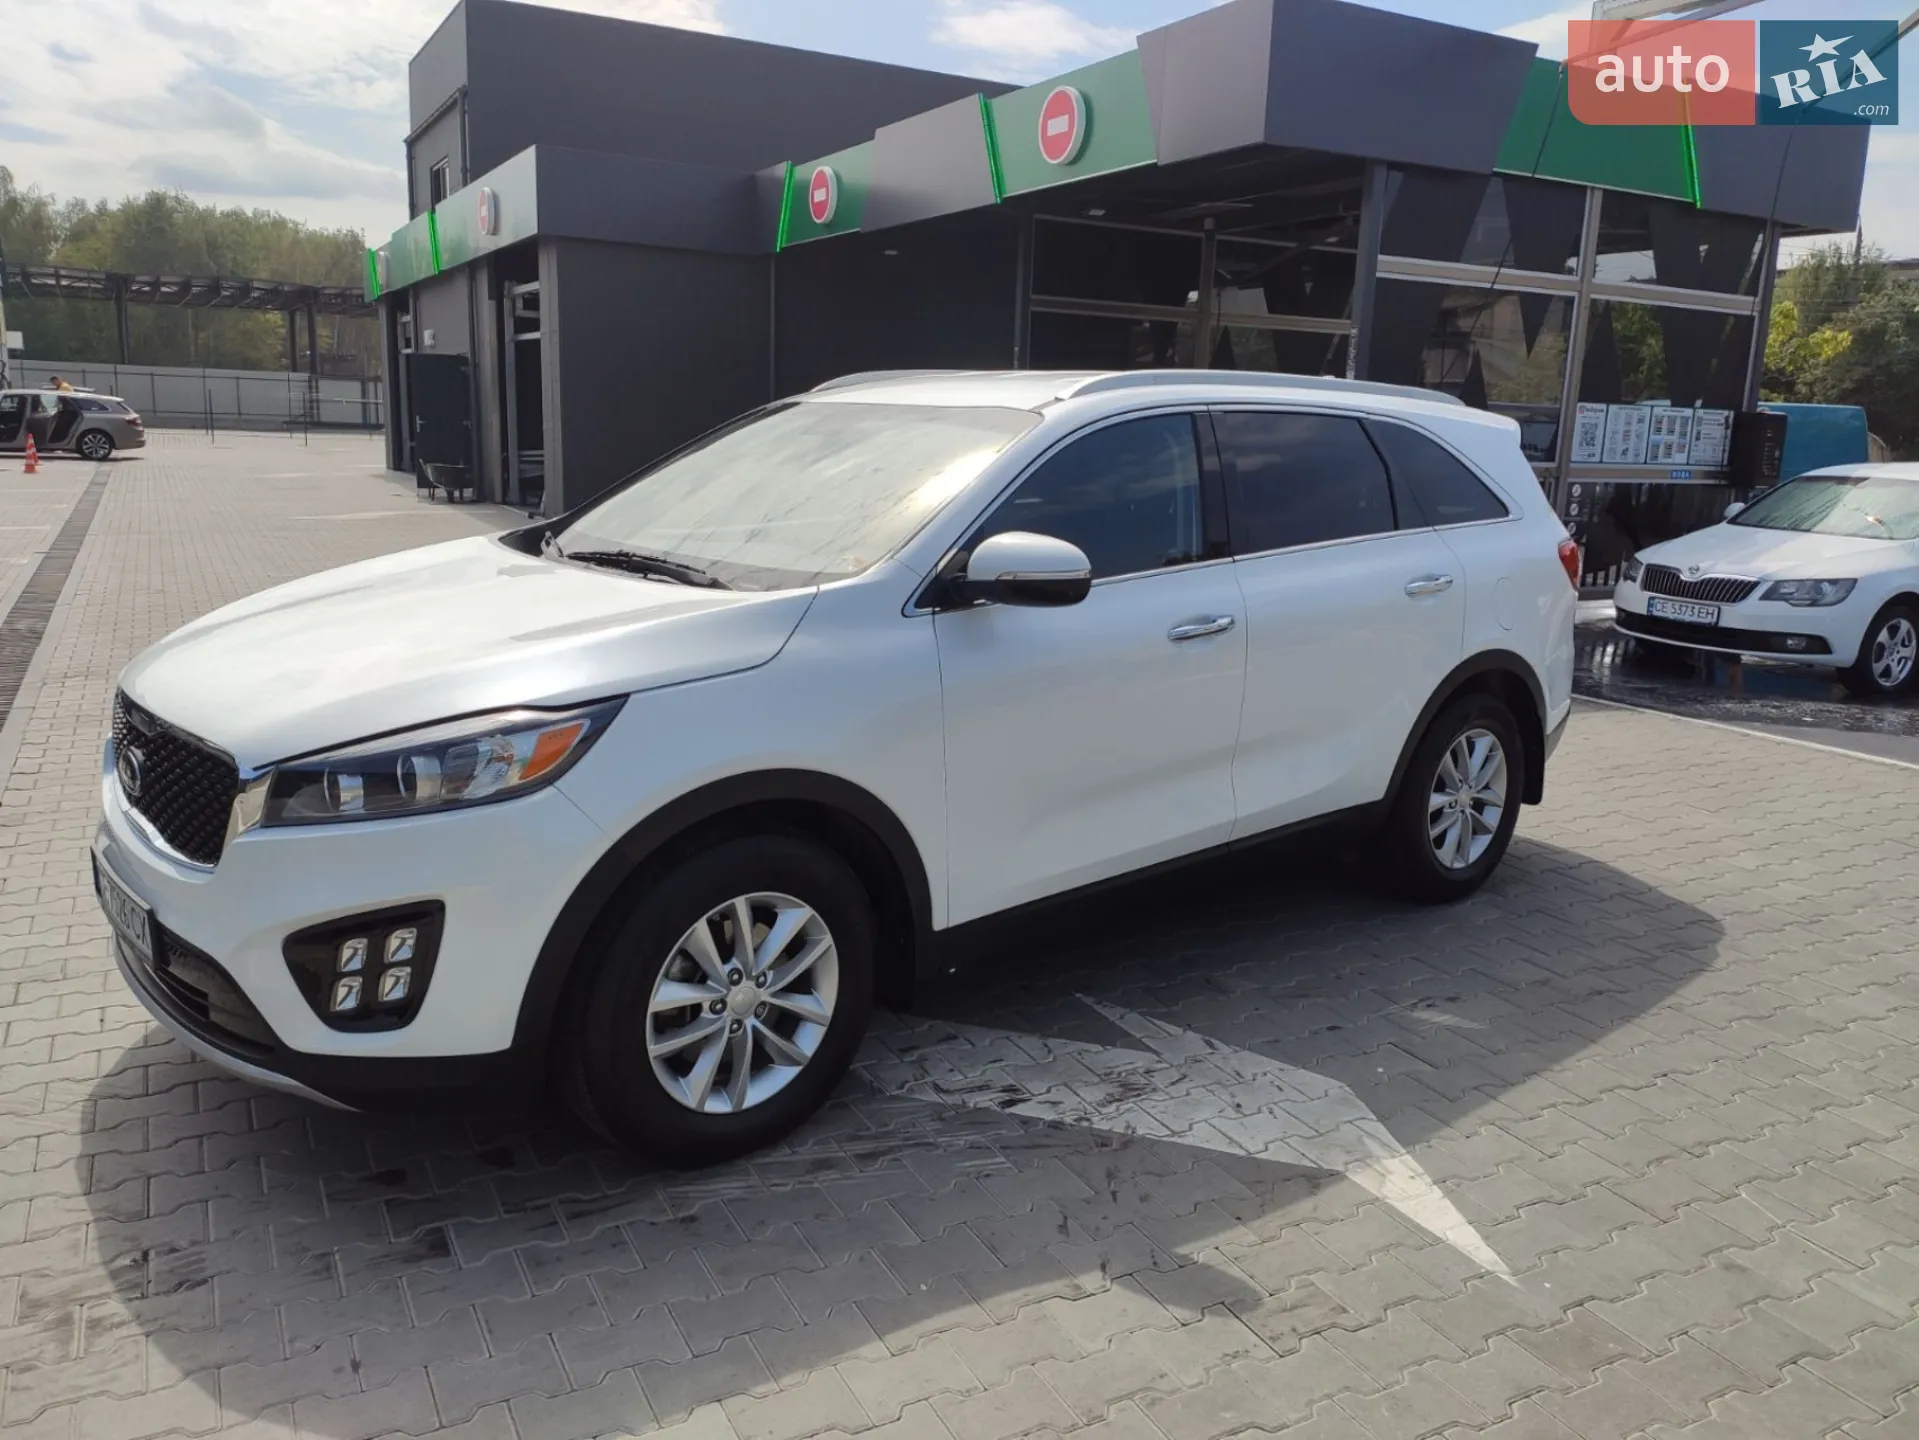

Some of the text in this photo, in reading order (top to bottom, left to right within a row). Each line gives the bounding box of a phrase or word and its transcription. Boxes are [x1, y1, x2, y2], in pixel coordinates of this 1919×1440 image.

[1655, 600, 1715, 620] CE 5373 EH
